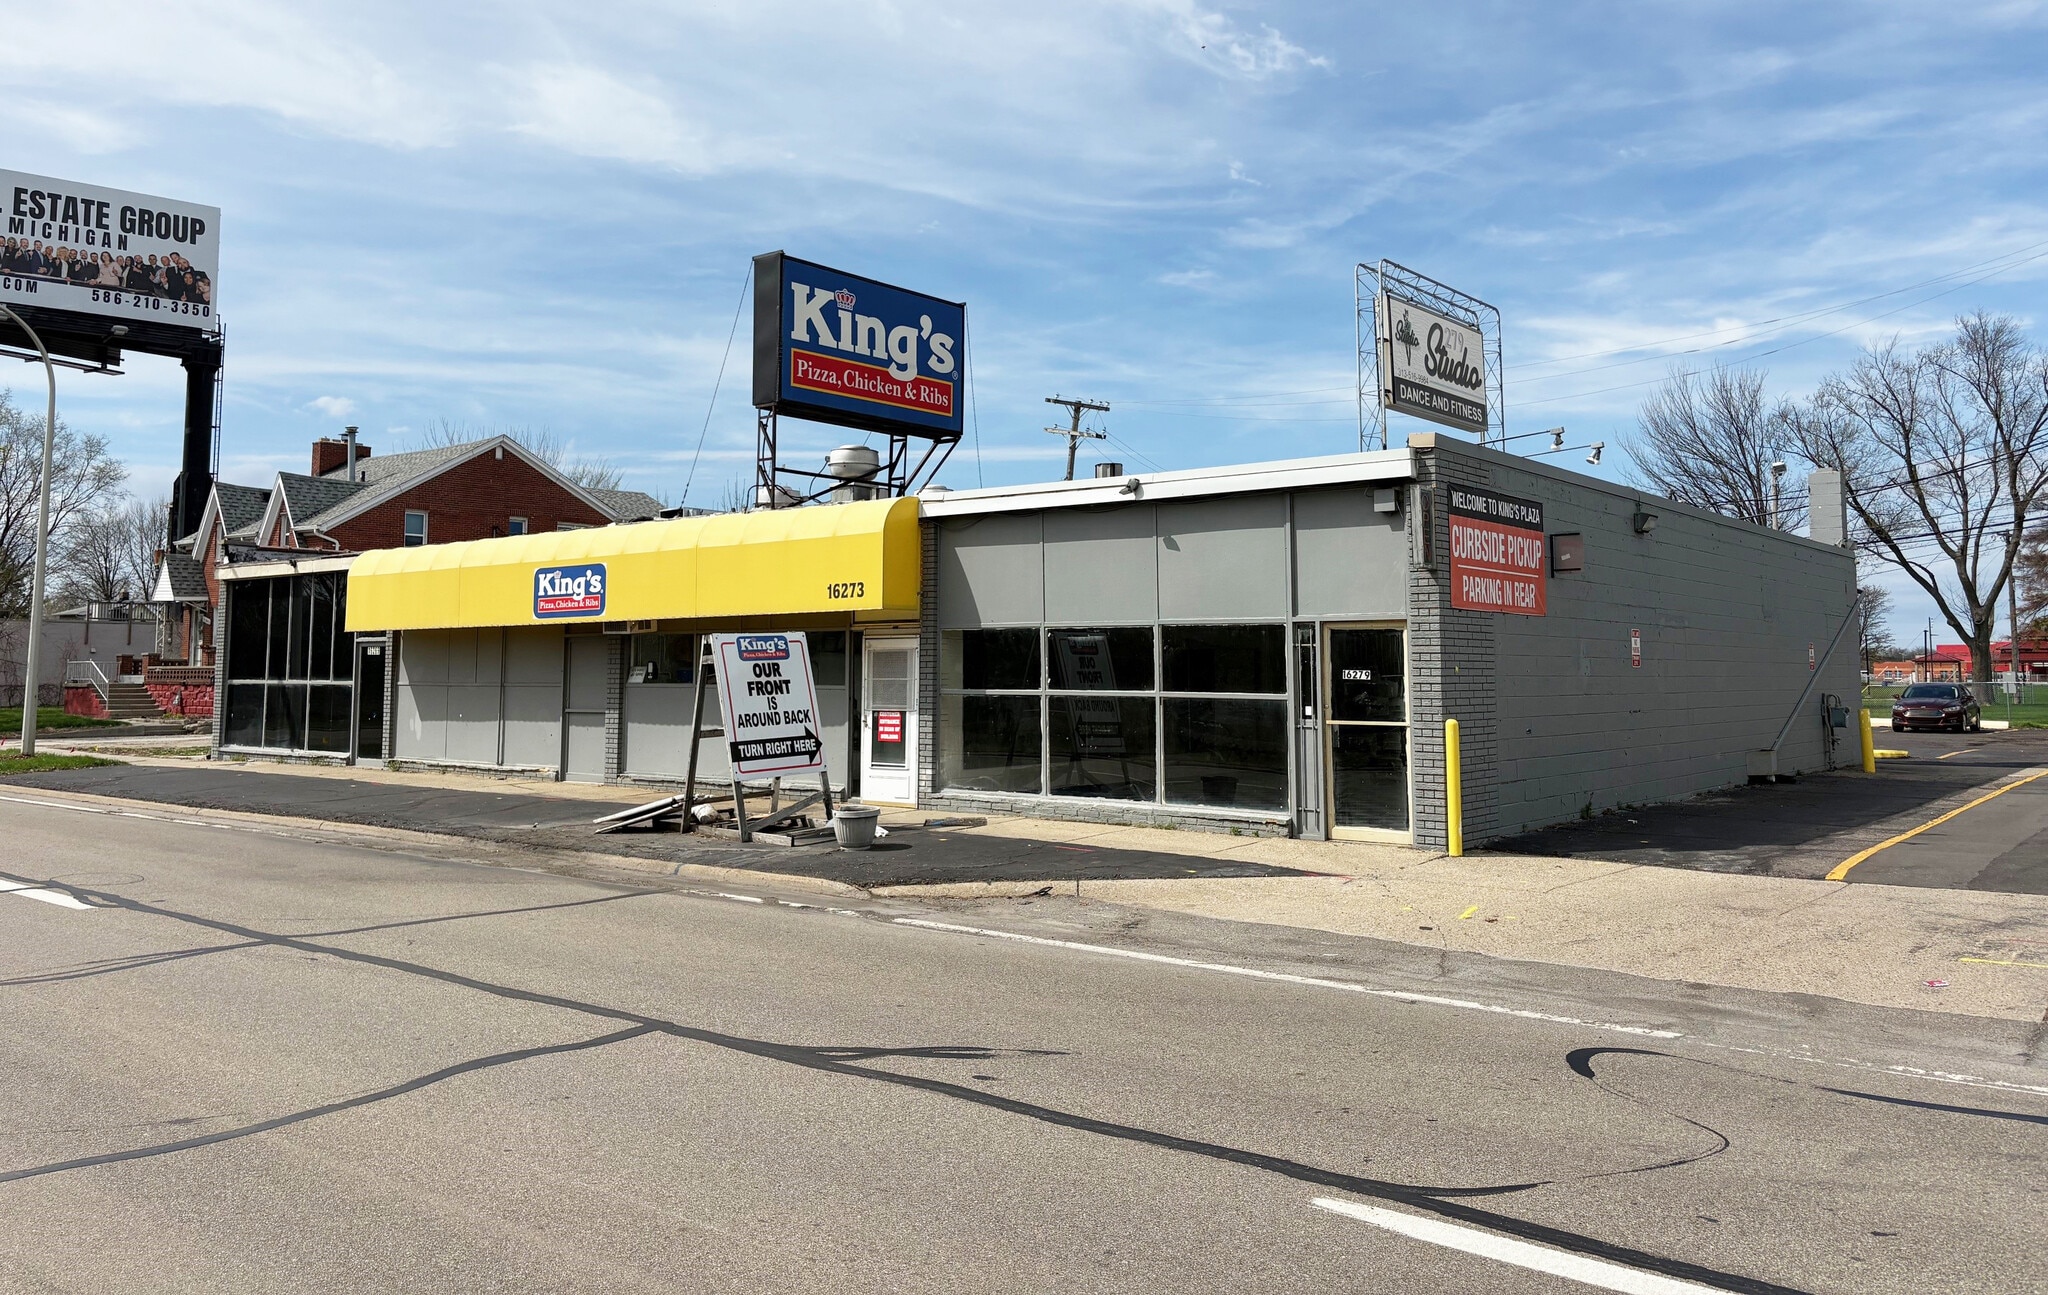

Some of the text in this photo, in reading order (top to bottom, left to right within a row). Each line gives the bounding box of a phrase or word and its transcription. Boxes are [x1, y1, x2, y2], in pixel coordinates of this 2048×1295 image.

[13, 187, 205, 245] ESTATE GROUP
[9, 217, 128, 251] MICHIGAN
[92, 290, 210, 317] 586-210-3350
[791, 282, 954, 381] King's
[1424, 322, 1482, 390] Studio
[797, 359, 949, 407] Pizza, Chicken & Ribs
[1400, 384, 1482, 422] DANCE AND FITNESS
[1451, 491, 1540, 524] WELCOME TO KING'S PLAZA
[1452, 525, 1541, 569] CURBSIDE PICKUP
[538, 570, 601, 600] King's
[827, 581, 865, 599] 16273
[1463, 575, 1536, 608] PARKING IN REAR
[556, 600, 578, 608] Chicken
[585, 598, 599, 607] Ribs
[739, 637, 786, 653] King's
[752, 662, 782, 678] OUR
[1343, 670, 1370, 679] 16279
[747, 679, 791, 696] FRONT
[767, 696, 778, 710] IS
[737, 709, 812, 728] AROUND BACK
[738, 738, 817, 758] TURN RIGHT HERE
